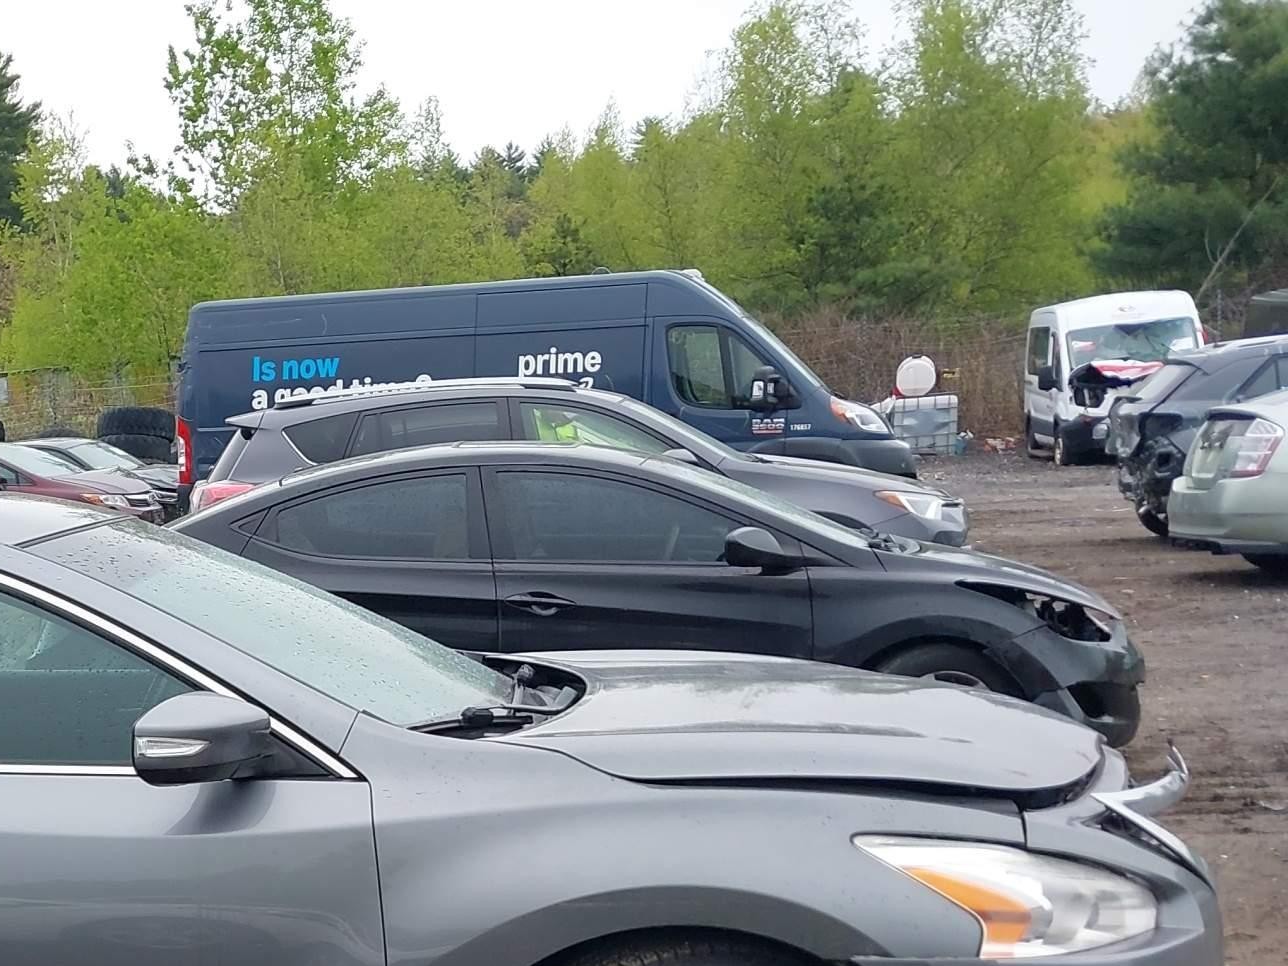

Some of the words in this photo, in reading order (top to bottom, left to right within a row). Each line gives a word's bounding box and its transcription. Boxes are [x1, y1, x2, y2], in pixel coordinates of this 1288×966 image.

[252, 356, 276, 382] Is
[282, 357, 340, 380] now
[518, 346, 602, 378] prime
[251, 389, 268, 410] a
